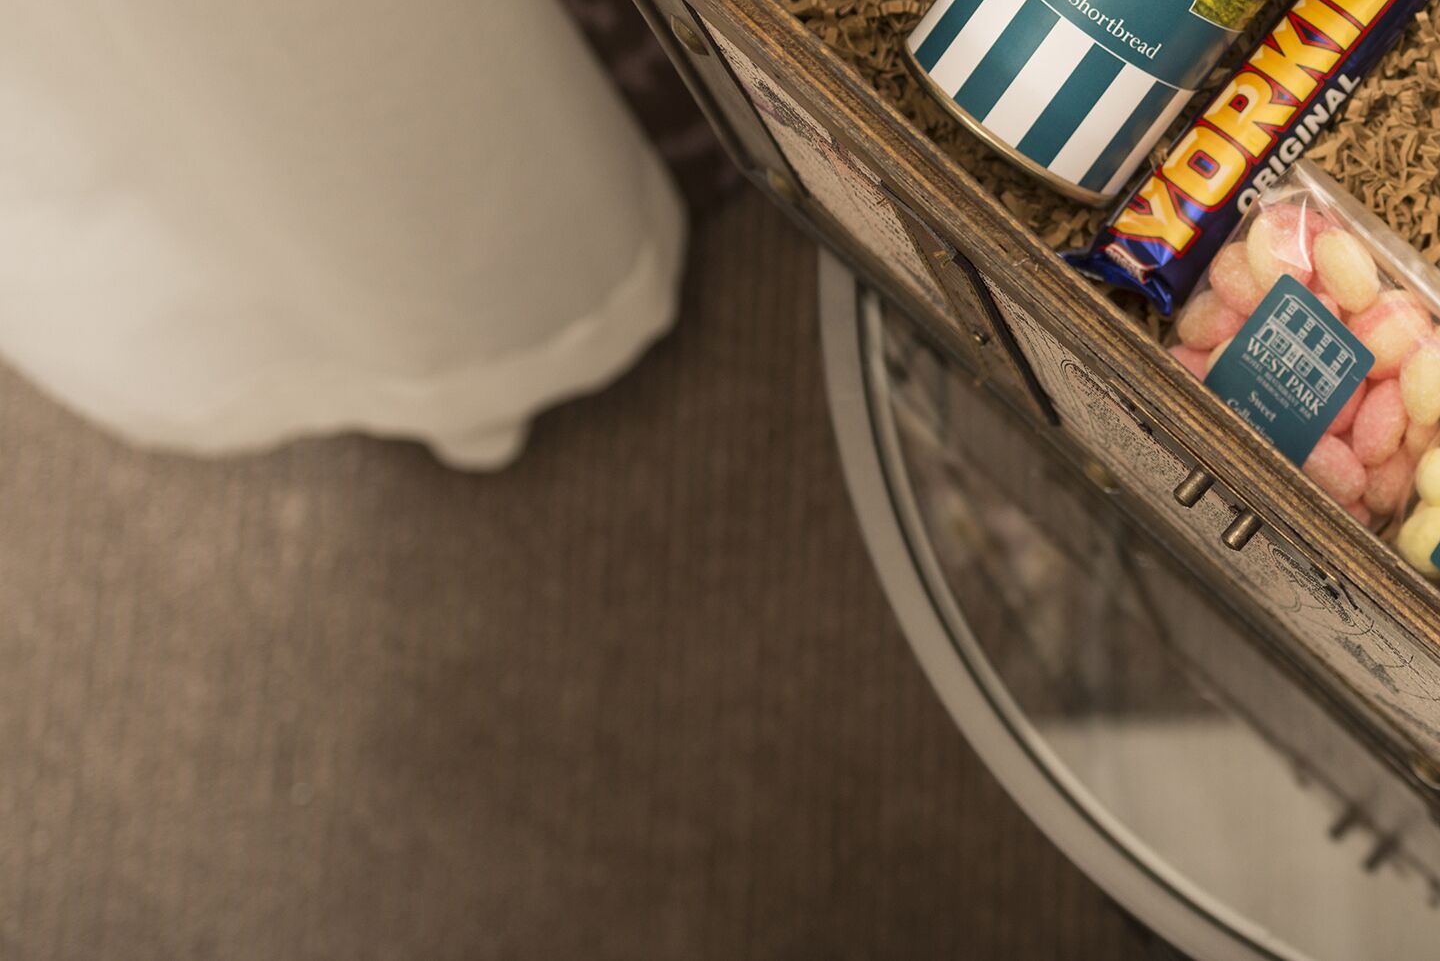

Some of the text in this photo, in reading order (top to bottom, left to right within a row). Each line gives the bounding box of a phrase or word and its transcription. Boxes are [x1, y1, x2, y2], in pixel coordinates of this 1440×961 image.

[1236, 73, 1362, 216] ORIGINAL
[1247, 336, 1326, 416] WEST PARK
[1248, 390, 1277, 423] Sweet
